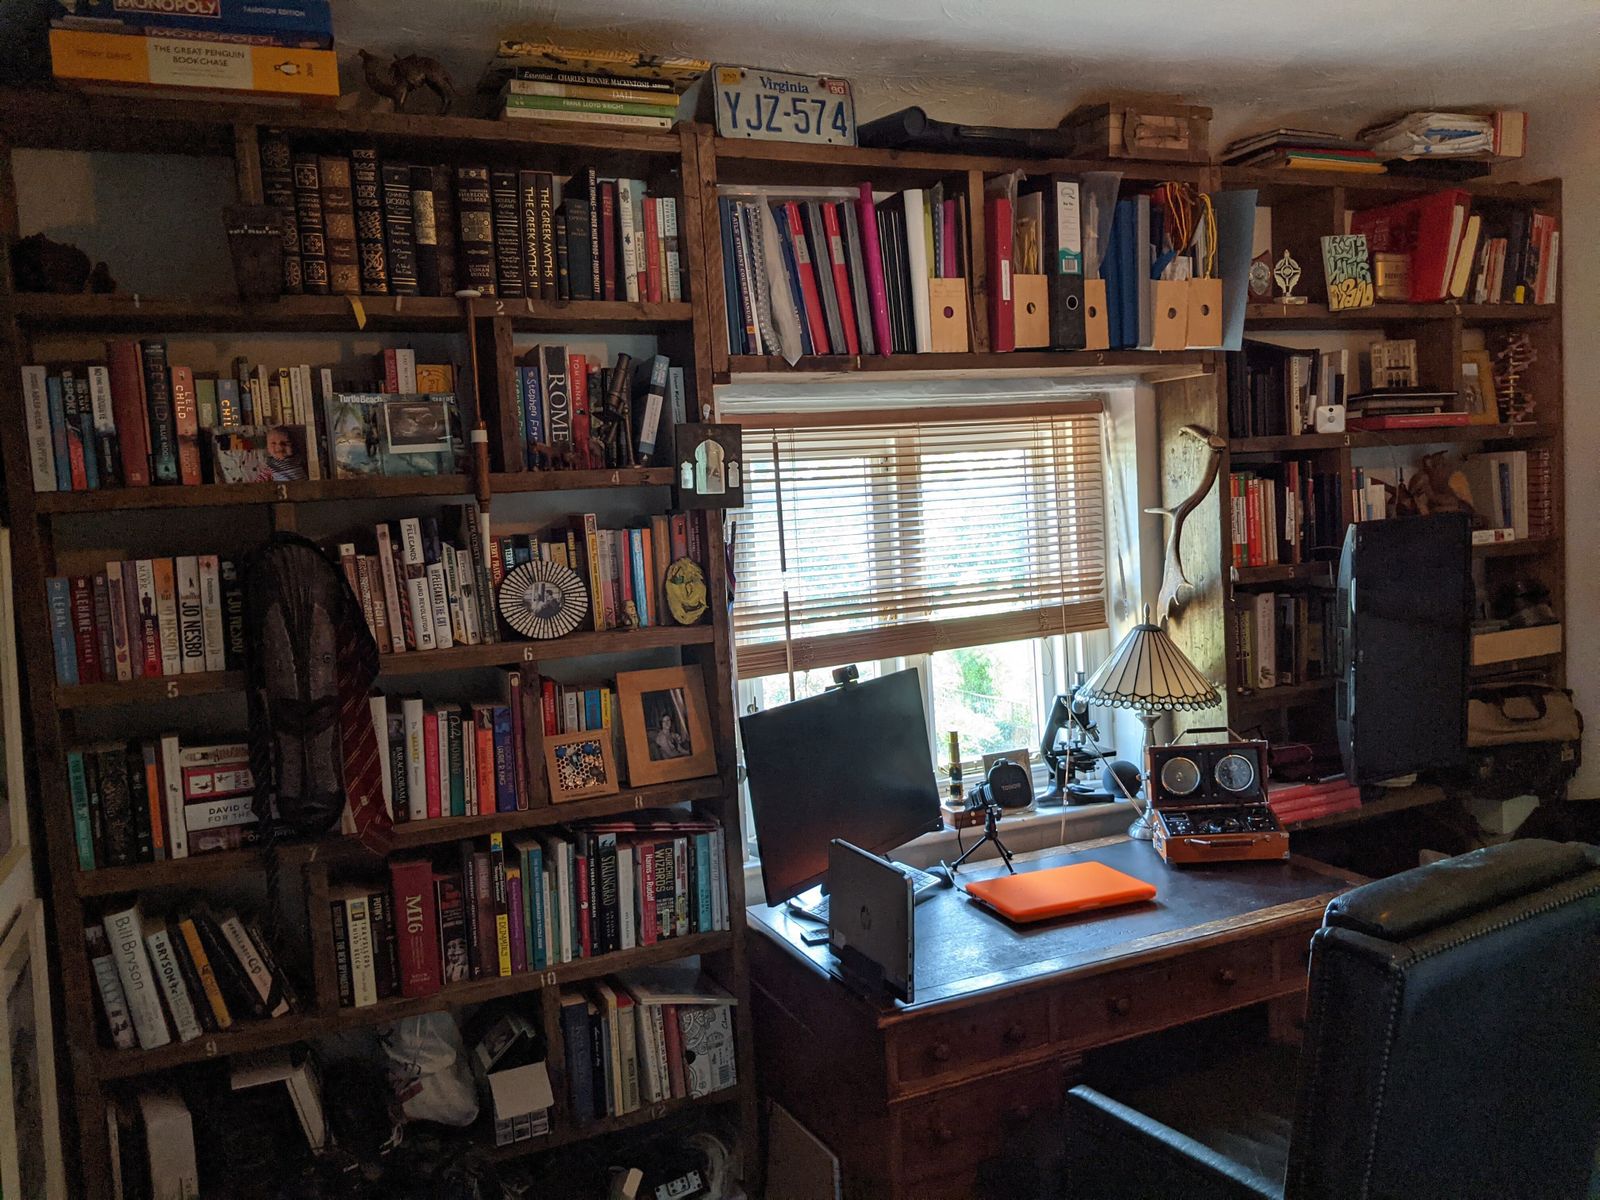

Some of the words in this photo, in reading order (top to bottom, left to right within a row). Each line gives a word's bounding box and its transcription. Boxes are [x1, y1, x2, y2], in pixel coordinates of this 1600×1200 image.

[116, 0, 216, 14] MONOPOLY
[154, 45, 171, 53] THE
[174, 46, 201, 55] GREAT
[205, 48, 245, 59] PENGUIN
[524, 71, 553, 81] Essential
[557, 74, 585, 83] CHARLES
[586, 76, 610, 85] RENNIE
[611, 79, 650, 88] MACKINTOSH
[760, 76, 809, 94] Virginia
[724, 91, 848, 137] YJZ-574
[524, 186, 533, 207] THE
[539, 187, 549, 208] THE
[525, 209, 535, 240] GREEK
[540, 210, 550, 240] GREEK
[526, 241, 537, 277] MYTHS
[542, 241, 552, 278] MYTHS
[735, 236, 743, 268] STUDENT
[739, 268, 747, 294] COURSE
[496, 301, 504, 315] 2
[742, 296, 750, 322] MANUAL
[149, 357, 164, 380] LEE
[62, 370, 76, 415] BESPOKE
[152, 382, 167, 421] CHILD
[175, 385, 186, 419] CHILD
[184, 391, 193, 412] LEE
[525, 379, 537, 416] Stephen
[573, 380, 581, 406] HANKS
[220, 399, 230, 427] CHIL
[547, 373, 568, 442] ROME
[158, 424, 168, 442] BLUE
[1344, 435, 1350, 446] 3
[611, 471, 620, 484] 4
[277, 484, 287, 499] 3
[405, 524, 416, 561] PELECANOS
[504, 547, 513, 565] TERRY
[491, 560, 501, 584] PRATCH
[1287, 567, 1295, 578] 5
[415, 581, 424, 597] HARD
[431, 574, 442, 605] PELECANOS
[51, 596, 65, 632] LEHAN
[75, 595, 90, 632] LEHANE
[181, 602, 199, 617] JO
[372, 600, 385, 627] Rain
[418, 597, 428, 632] REVOLUTION
[434, 605, 443, 615] THE
[436, 616, 446, 627] CUT
[144, 619, 153, 635] HEAD
[183, 620, 202, 657] NESBO
[146, 645, 156, 662] STATE
[524, 647, 533, 661] 6
[167, 681, 179, 698] 5
[395, 746, 404, 776] BARACK
[450, 740, 459, 775] NOMAD
[398, 777, 406, 804] OBAMA
[208, 814, 229, 823] FOR
[209, 803, 240, 815] DAVID
[644, 853, 653, 873] Hanns
[653, 849, 665, 892] WIZARDS
[664, 848, 673, 891] CHURCHILL'S
[600, 856, 616, 905] STALINGRAD
[645, 881, 654, 901] Rudolf
[372, 897, 382, 921] PUTIN'S
[404, 894, 422, 933] MI6
[114, 916, 131, 940] Bill
[121, 940, 144, 991] Bryson
[154, 942, 174, 983] BRYSON
[541, 971, 556, 987] 10
